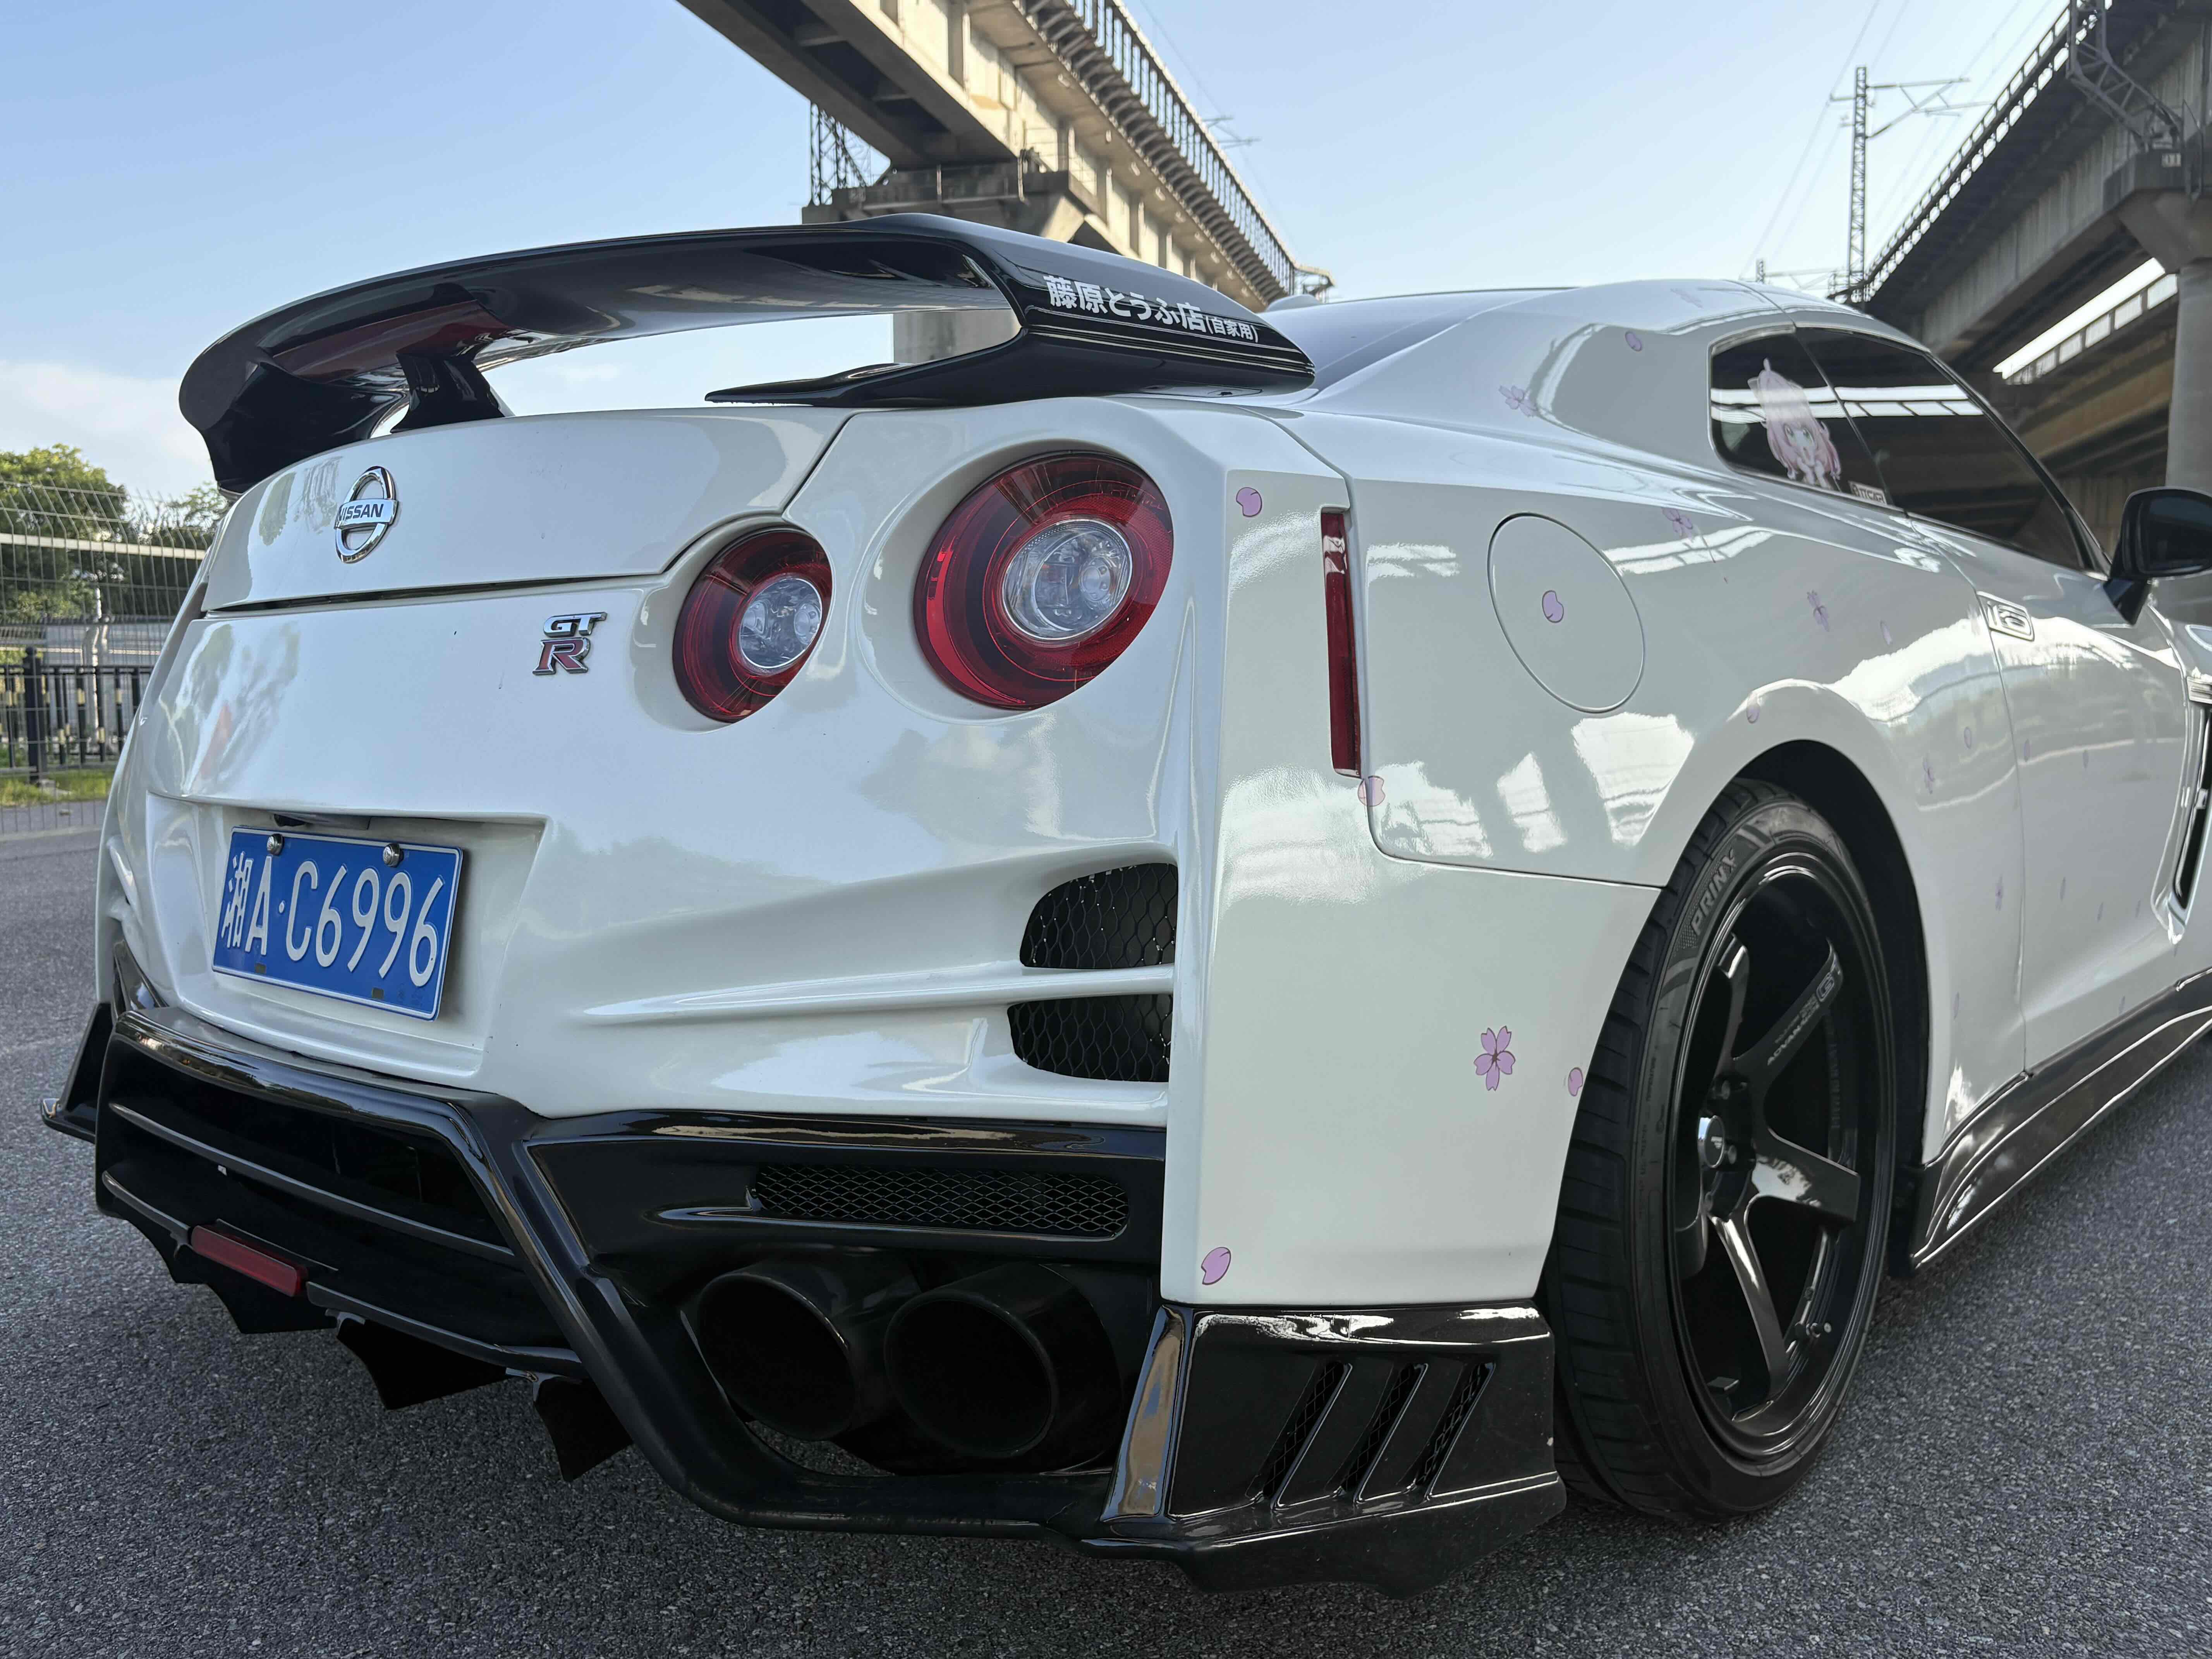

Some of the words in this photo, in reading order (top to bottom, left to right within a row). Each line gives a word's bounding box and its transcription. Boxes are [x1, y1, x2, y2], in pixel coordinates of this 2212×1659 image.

[1043, 275, 1258, 343] 藤原とうふ店(自家用)
[338, 503, 384, 521] NISSAN
[543, 611, 607, 637] GT
[532, 637, 590, 675] R
